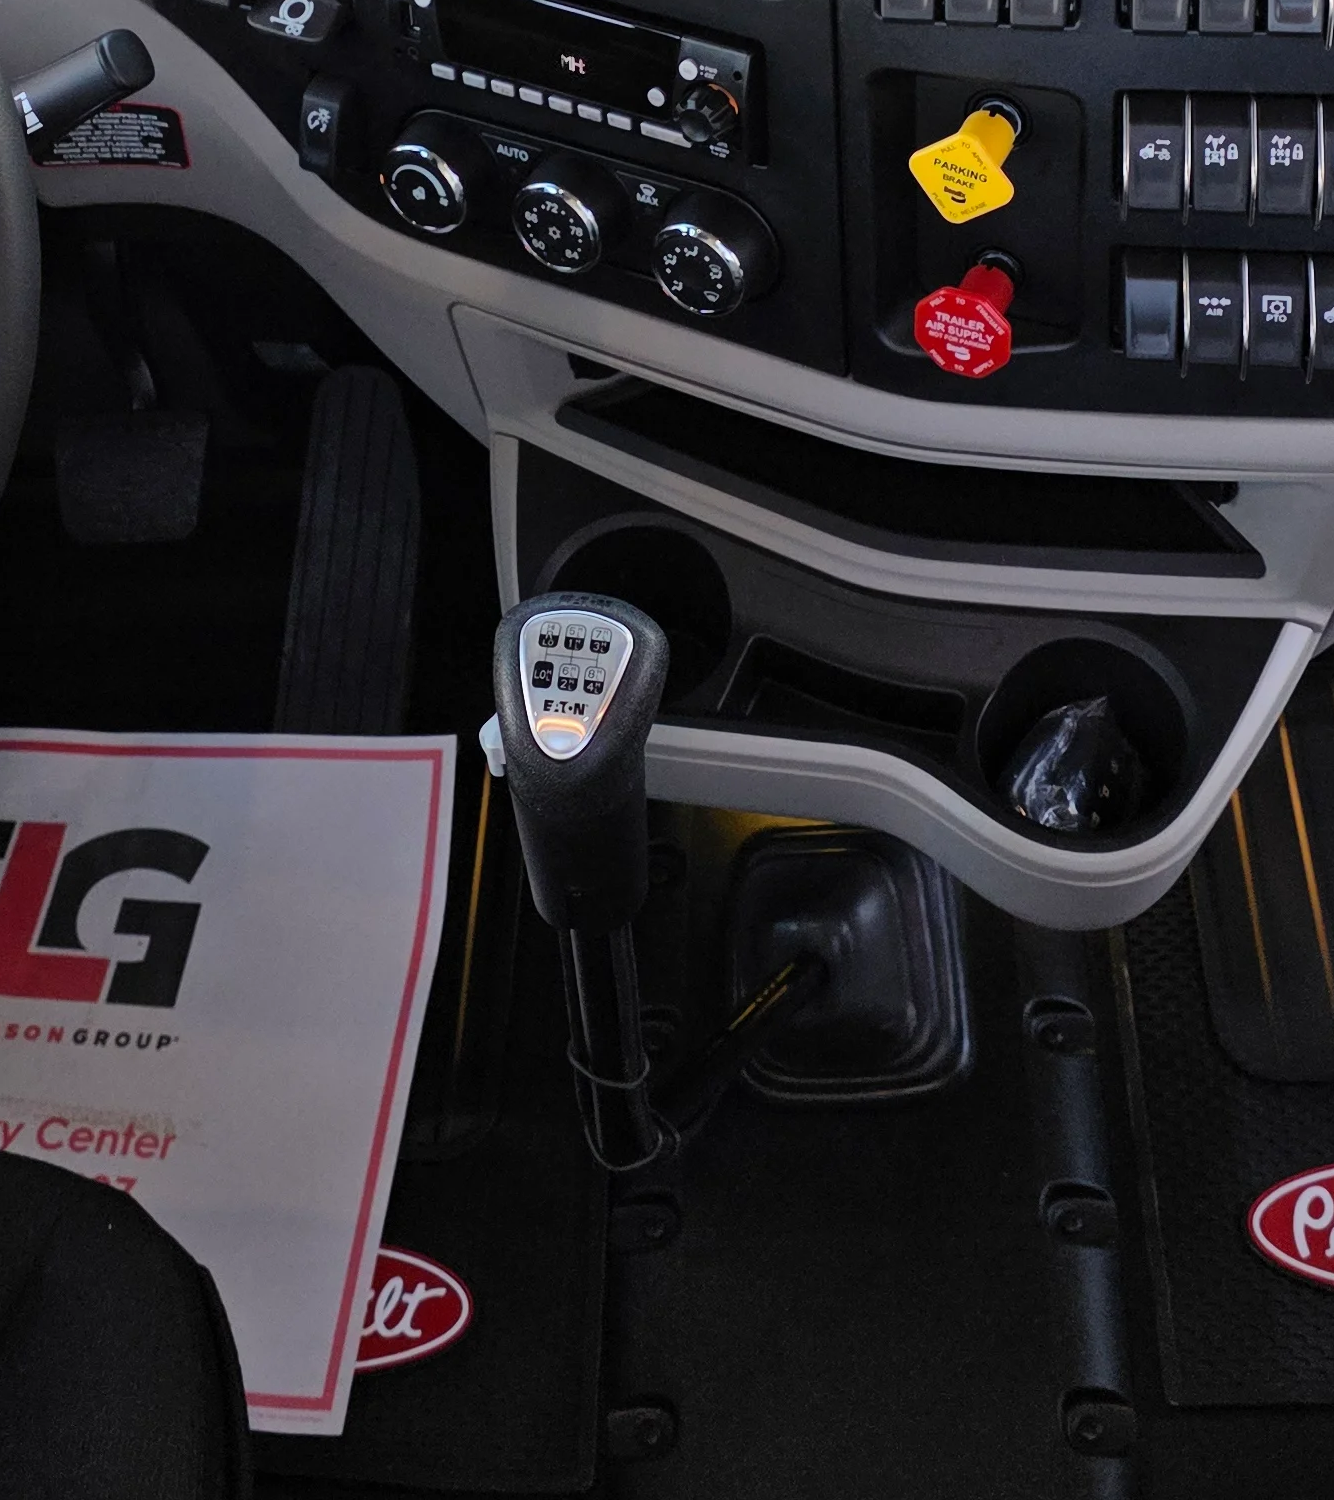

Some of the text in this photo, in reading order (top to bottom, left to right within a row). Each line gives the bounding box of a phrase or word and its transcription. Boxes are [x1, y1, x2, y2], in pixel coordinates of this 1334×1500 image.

[961, 141, 971, 150] TO
[496, 143, 529, 162] AUTO
[933, 157, 988, 183] PARKING
[942, 173, 976, 190] BRAKE
[636, 192, 659, 207] MAX
[545, 200, 559, 214] 72
[960, 201, 988, 216] RELEASE
[570, 225, 584, 238] 78
[955, 296, 966, 306] TO
[1205, 307, 1224, 317] AIR
[935, 310, 985, 333] TRAILER
[1265, 313, 1288, 323] PTO
[925, 319, 995, 345] AIR SUPPLY
[928, 329, 944, 339] NOT
[943, 334, 959, 343] FOR
[958, 338, 991, 351] PARKING
[569, 626, 576, 635] 5
[595, 630, 602, 639] 7
[568, 639, 572, 648] 1
[592, 642, 600, 651] 3
[562, 666, 569, 675] 6
[587, 669, 595, 679] 8
[559, 680, 568, 689] 2
[586, 682, 594, 692] 4
[71, 1027, 173, 1051] GROUP
[36, 1114, 178, 1161] Center
